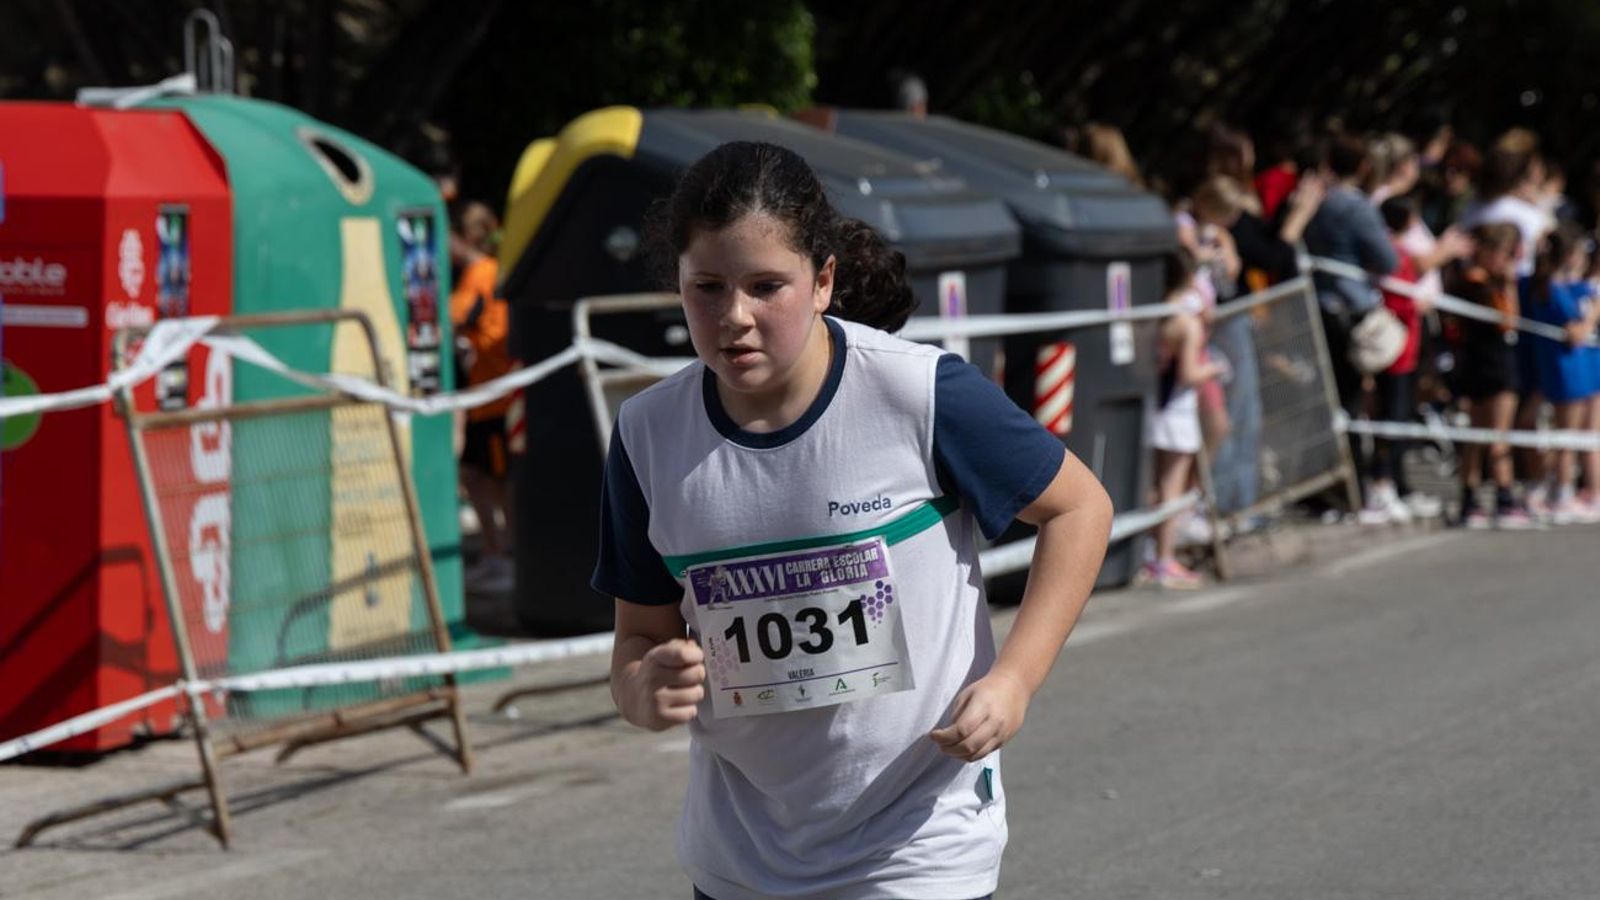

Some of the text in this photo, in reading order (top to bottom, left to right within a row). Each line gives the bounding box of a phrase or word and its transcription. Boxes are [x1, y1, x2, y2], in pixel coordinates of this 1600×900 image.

[828, 493, 892, 517] Poveda
[785, 548, 878, 575] CARRERA ESCOLAR
[724, 563, 787, 597] XXXVI
[796, 564, 869, 588] LA GLORIA
[724, 599, 869, 664] 1031
[787, 668, 815, 680] VALERIA
